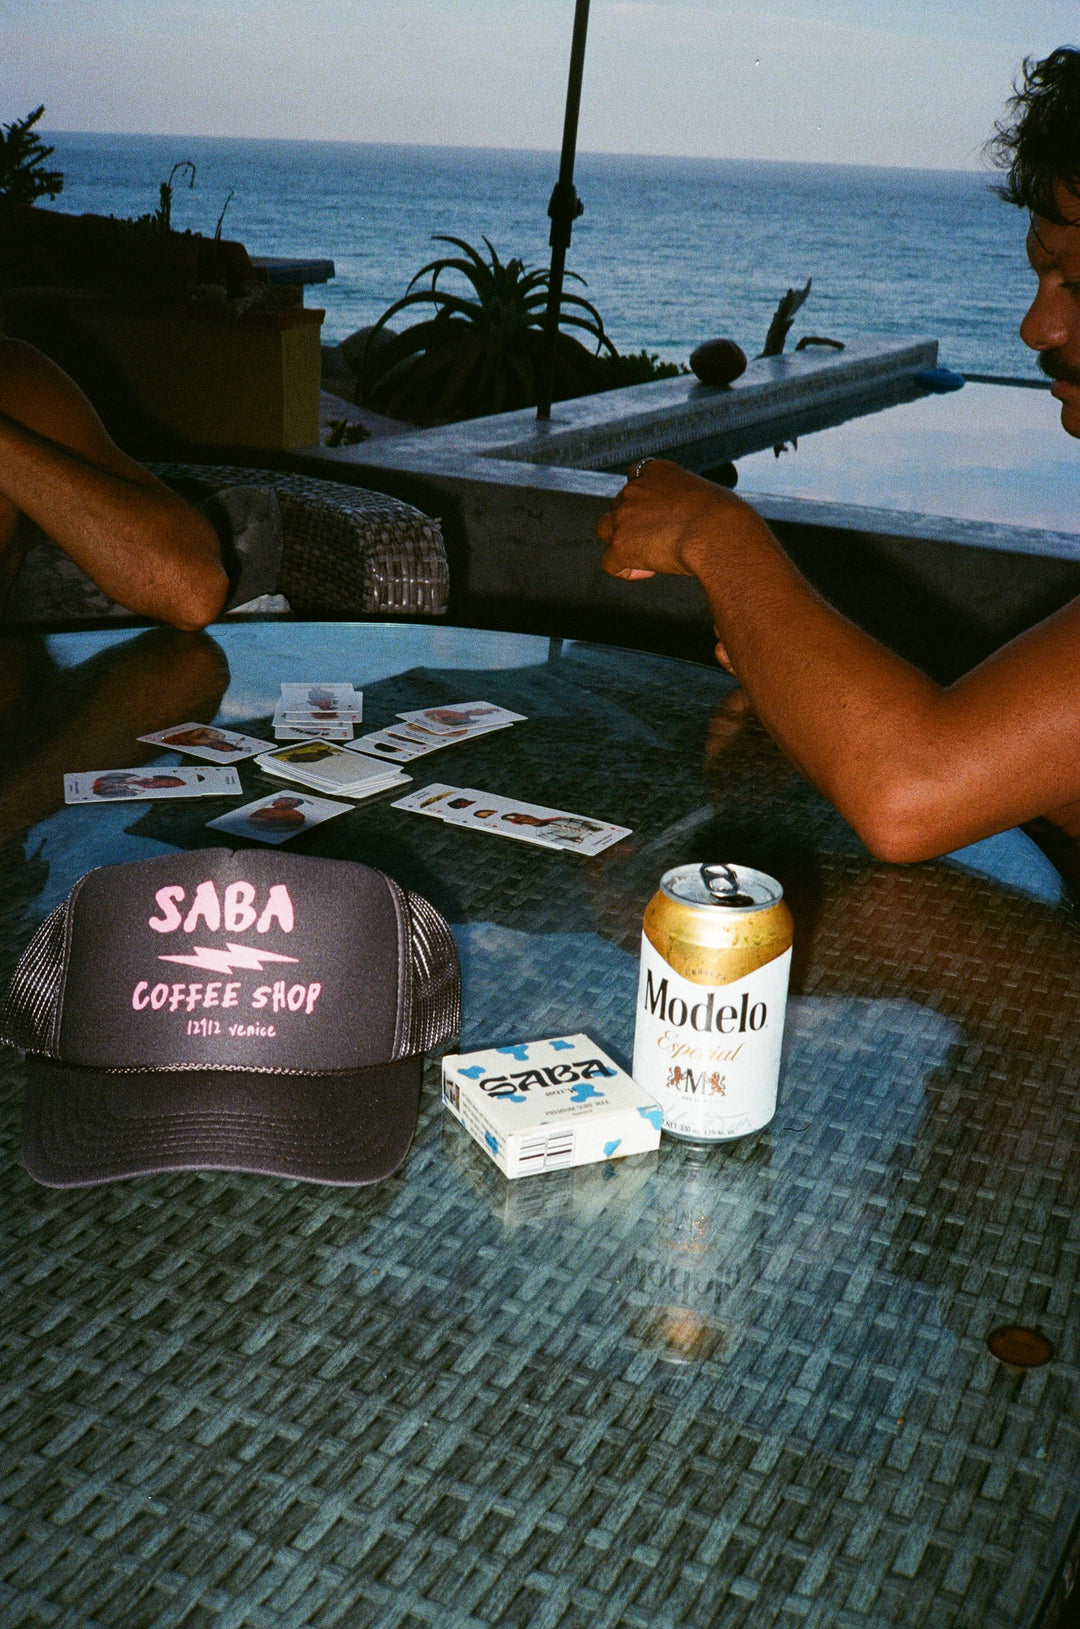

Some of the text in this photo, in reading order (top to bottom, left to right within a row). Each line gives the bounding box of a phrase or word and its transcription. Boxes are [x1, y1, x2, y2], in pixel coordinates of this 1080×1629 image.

[149, 880, 294, 933] SABA
[132, 980, 321, 1014] COFFEE SHOP
[644, 968, 767, 1034] Modelo
[228, 1021, 276, 1038] venice
[479, 1059, 612, 1098] SABA
